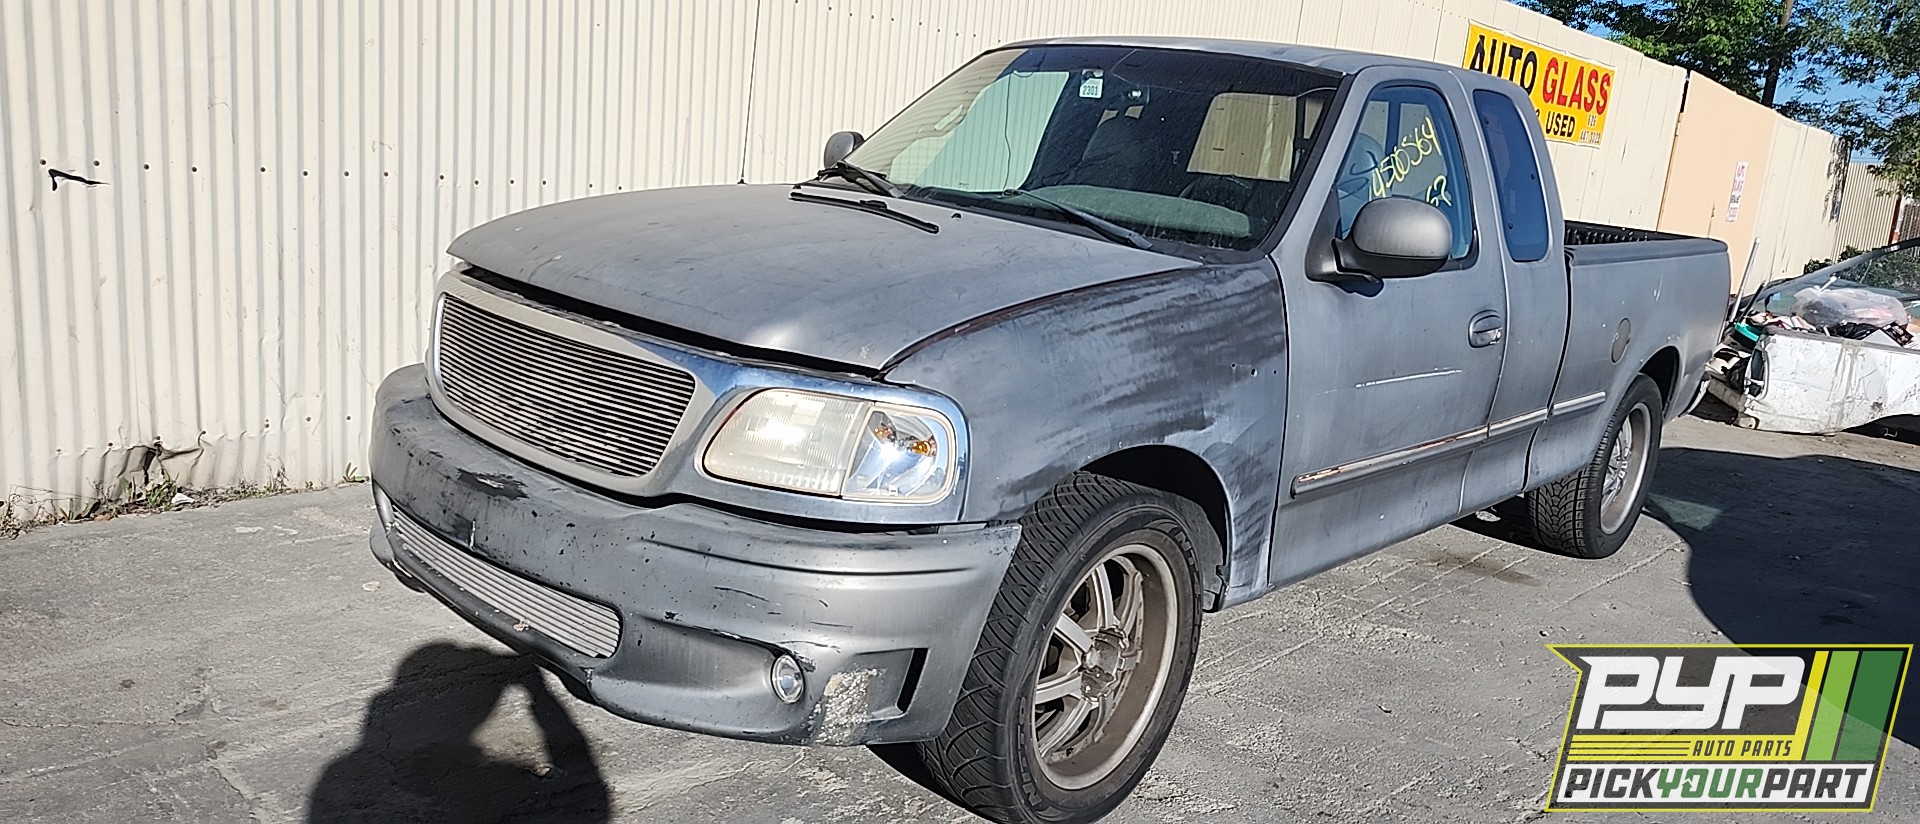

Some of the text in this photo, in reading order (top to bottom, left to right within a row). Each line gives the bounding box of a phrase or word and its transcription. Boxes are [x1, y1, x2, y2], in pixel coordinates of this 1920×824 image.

[1469, 34, 1611, 116] AUTO GLASS
[1082, 85, 1099, 96] 2301
[1545, 110, 1576, 138] USED
